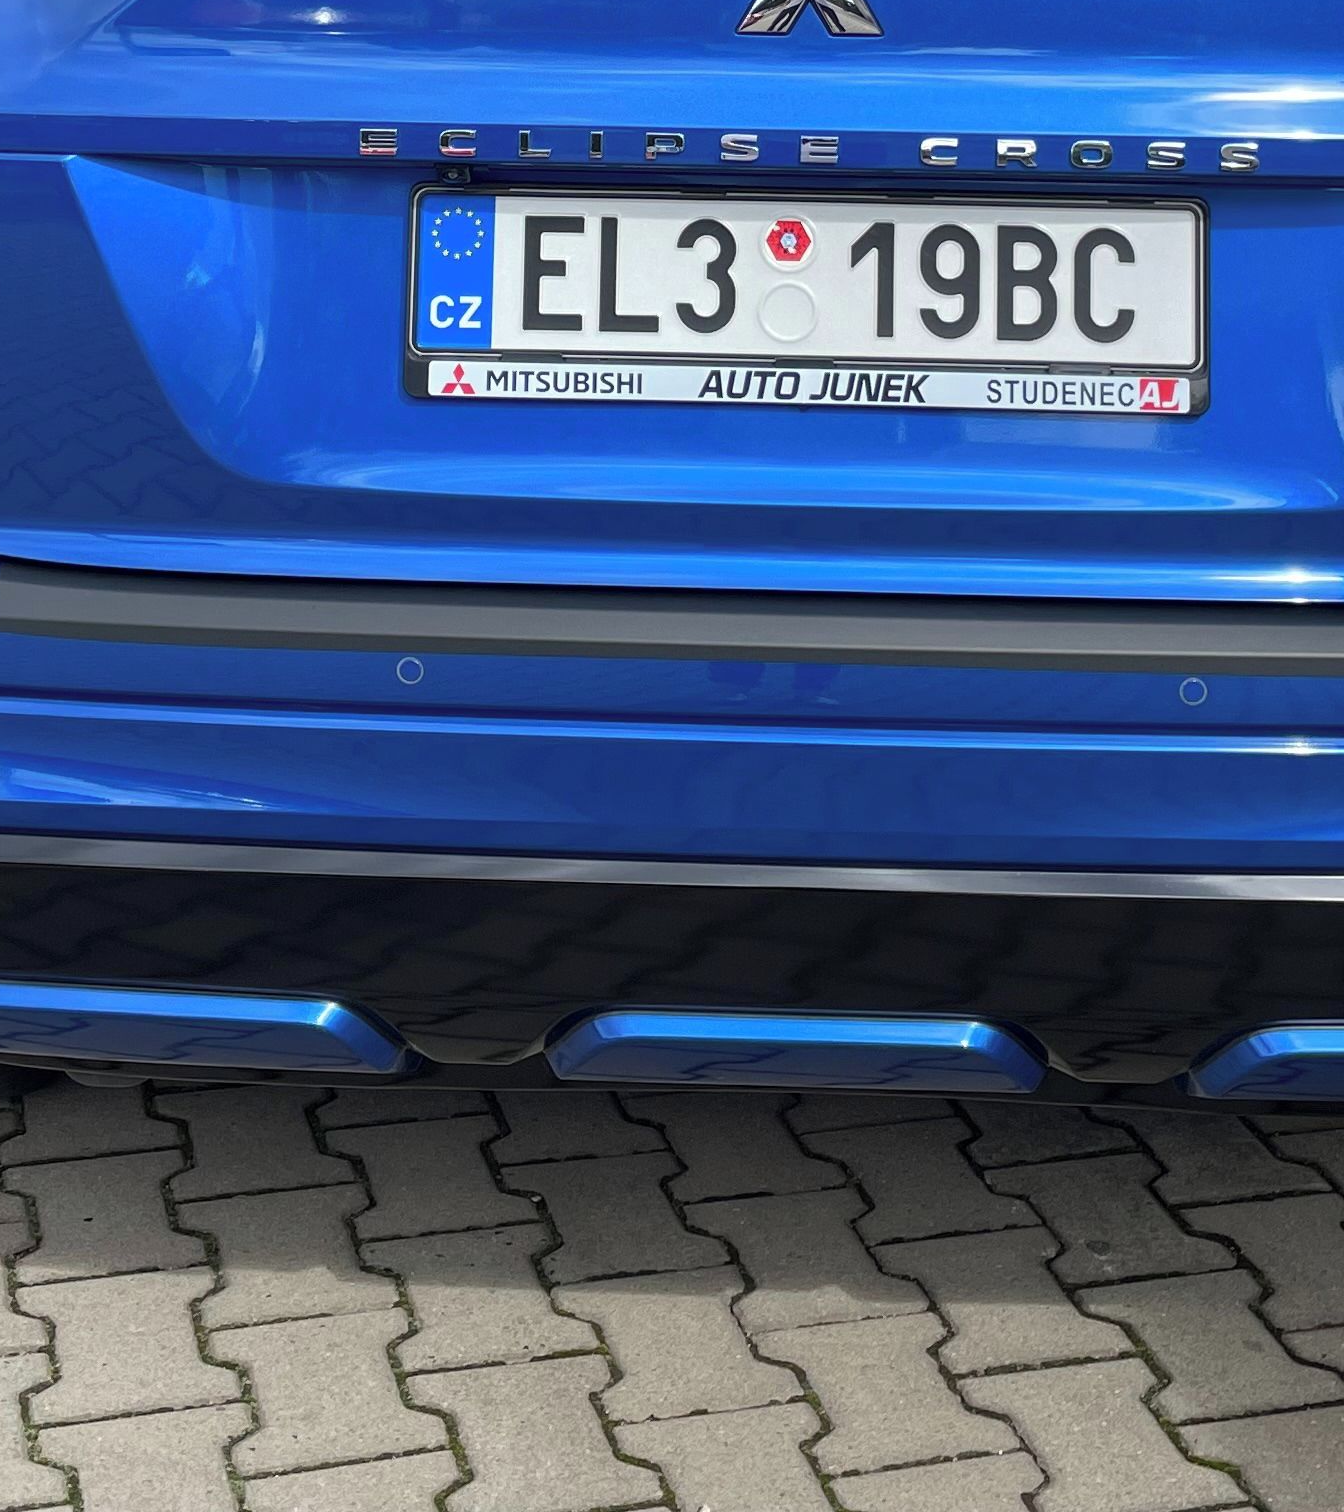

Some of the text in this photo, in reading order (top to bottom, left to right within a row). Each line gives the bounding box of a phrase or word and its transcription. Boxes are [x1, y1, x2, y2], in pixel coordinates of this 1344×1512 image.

[359, 128, 1259, 172] ECLIPSE CROSS
[522, 214, 1137, 345] EL3 19BC
[429, 294, 483, 330] CZ
[486, 369, 643, 395] MITSUBISHI
[698, 370, 799, 399] AUTO
[808, 372, 930, 405] JUNEK
[986, 379, 1136, 408] STUDENEC
